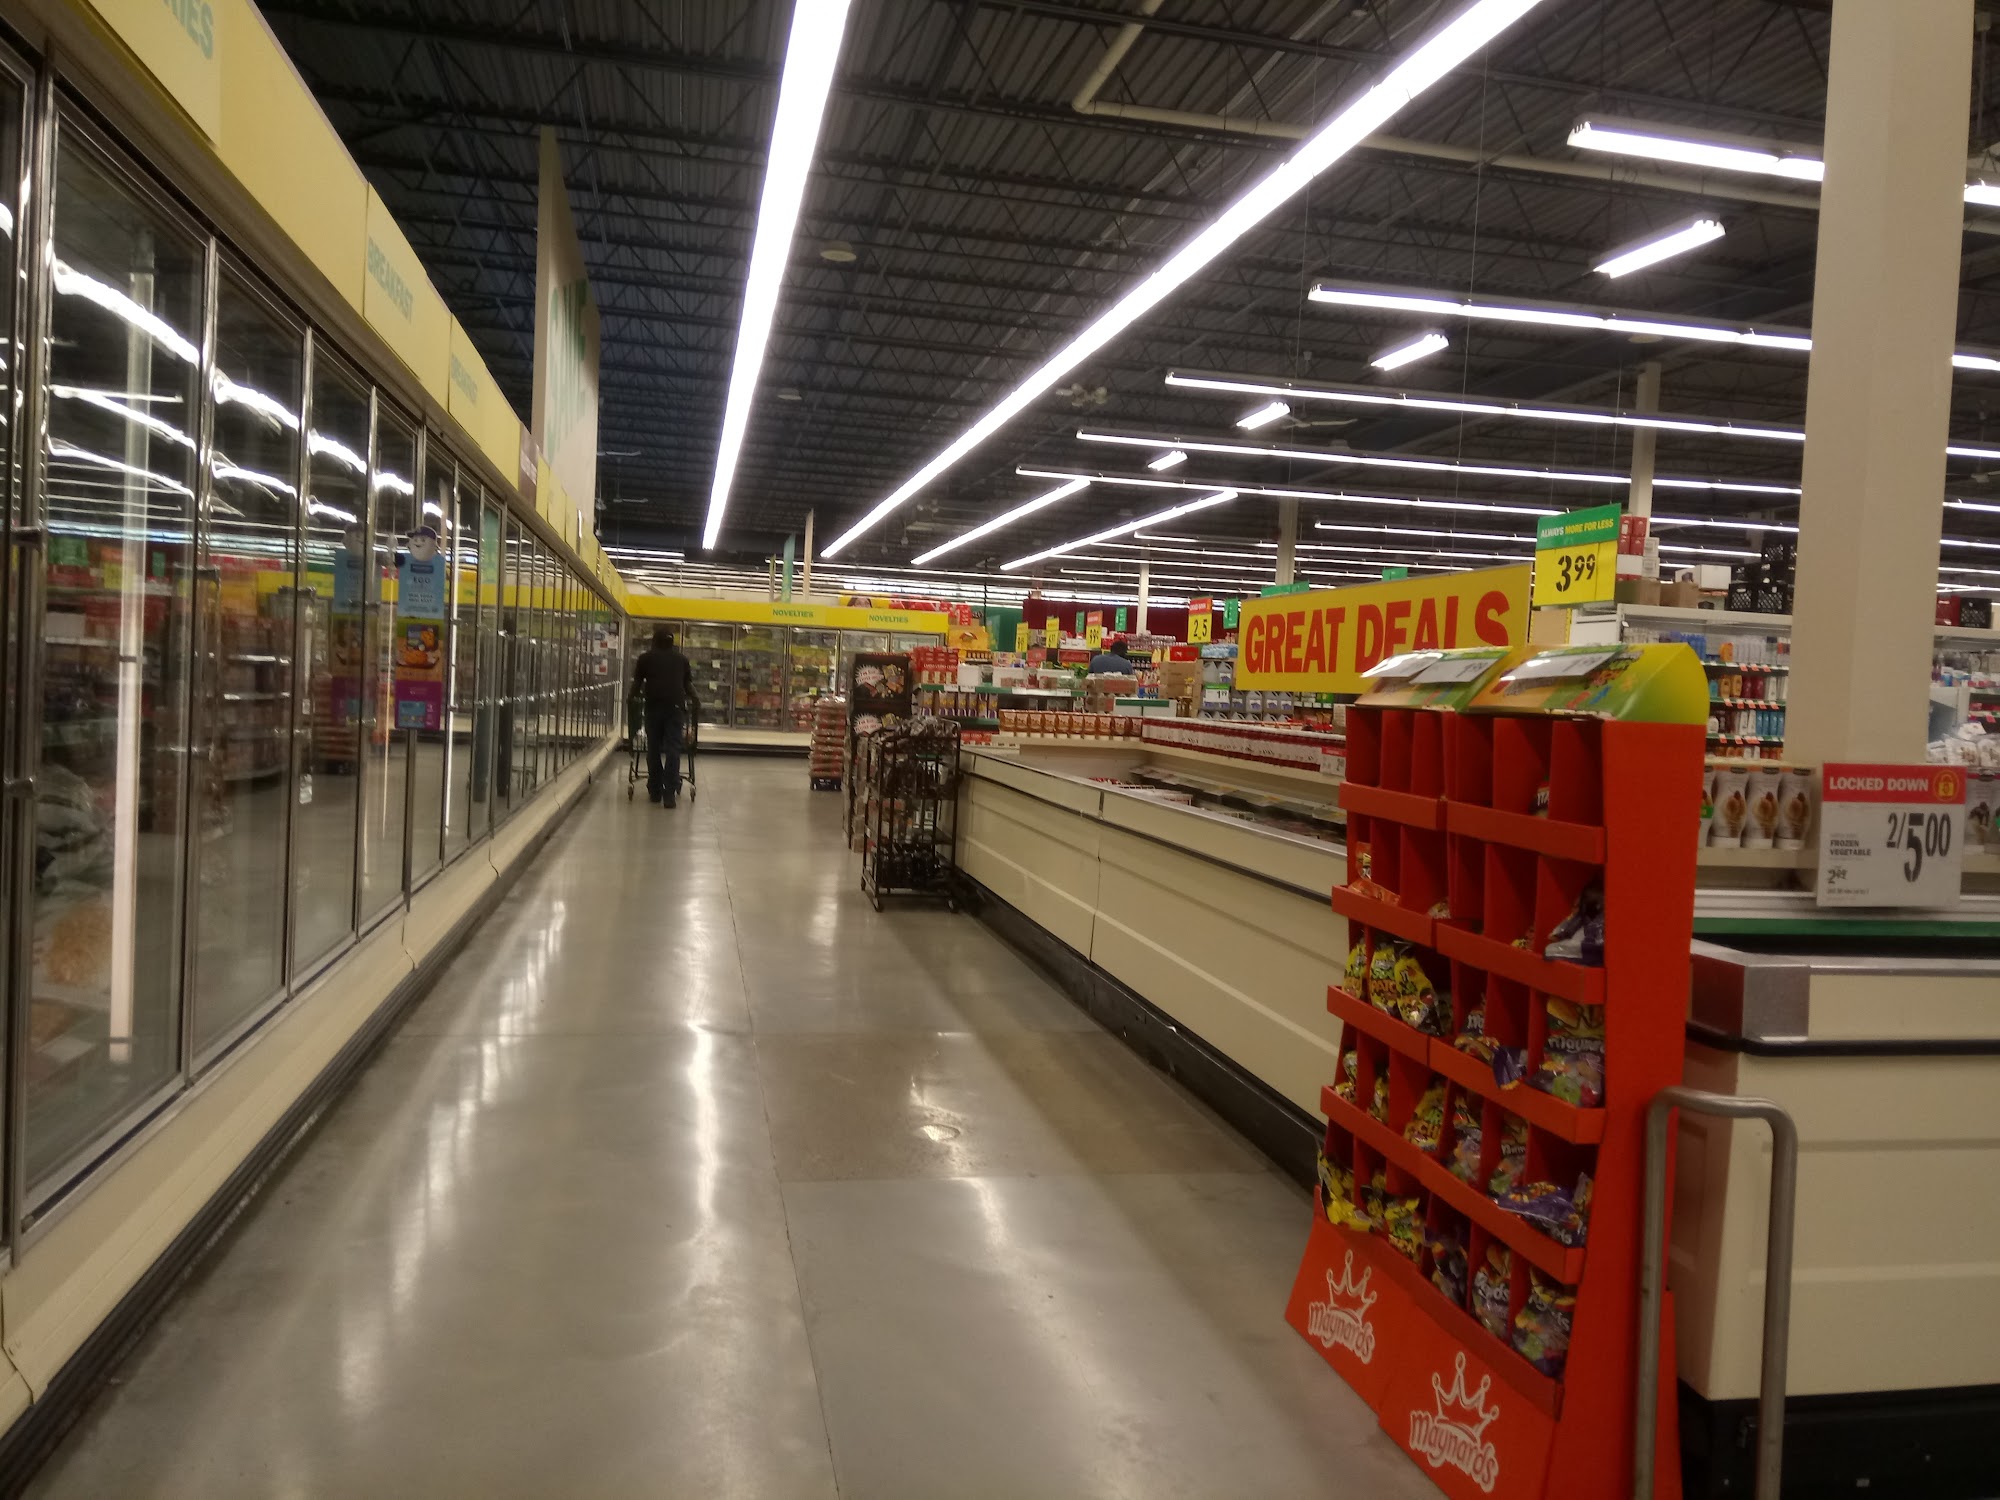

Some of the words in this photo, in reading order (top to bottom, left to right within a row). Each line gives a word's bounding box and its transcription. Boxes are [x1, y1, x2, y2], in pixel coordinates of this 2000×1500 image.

[368, 236, 413, 324] BREAKFAST
[1541, 526, 1564, 538] ALWAYS
[1564, 523, 1583, 535] MORE
[1584, 520, 1597, 532] FOR
[1597, 518, 1614, 530] LESS
[772, 608, 814, 619] NOVELTIES
[868, 614, 909, 624] NOVELTIES
[1245, 606, 1346, 674] GREAT
[1354, 590, 1511, 674] DEALS
[1829, 777, 1885, 791] LOCKED
[1887, 778, 1929, 792] DOWN
[1829, 840, 1860, 848] FROZEN
[1829, 848, 1872, 857] VEGETABLE
[1409, 1410, 1500, 1493] Maynards
